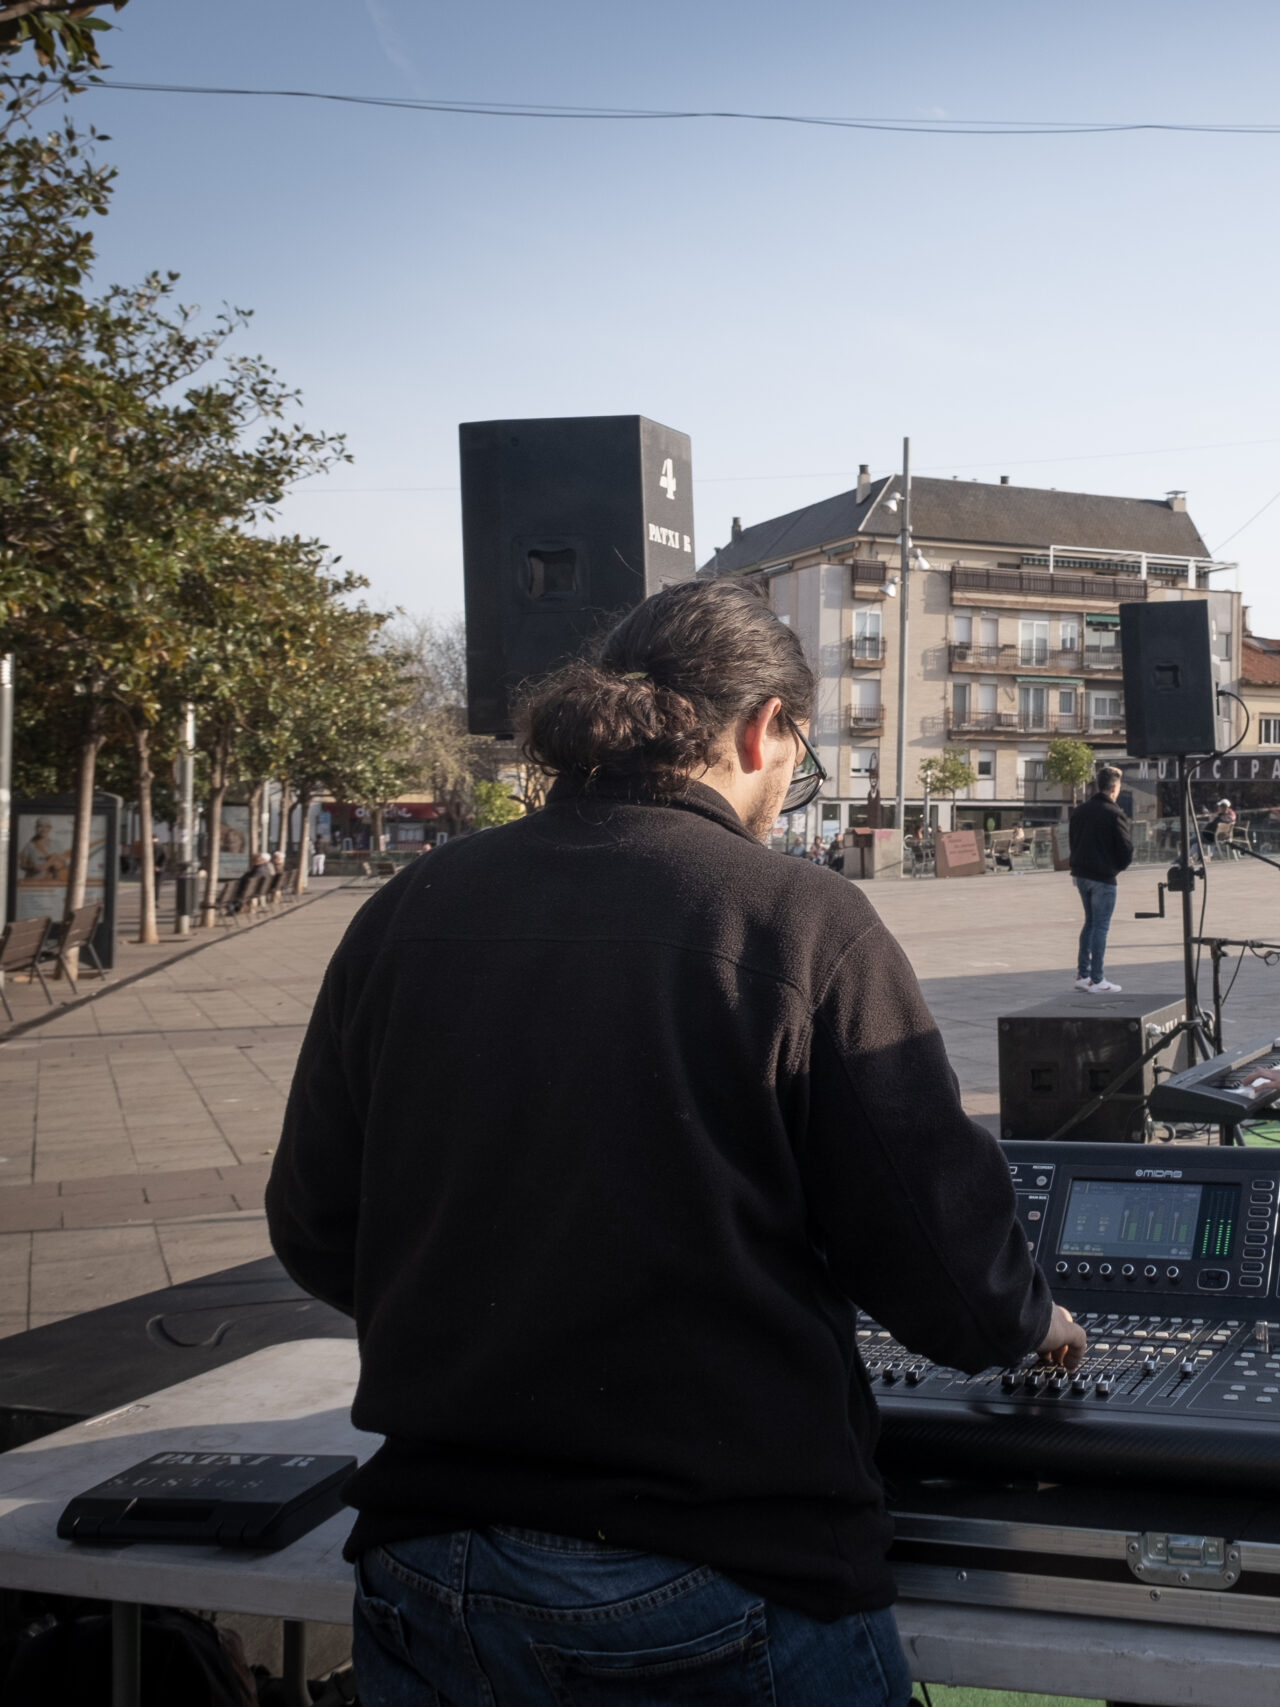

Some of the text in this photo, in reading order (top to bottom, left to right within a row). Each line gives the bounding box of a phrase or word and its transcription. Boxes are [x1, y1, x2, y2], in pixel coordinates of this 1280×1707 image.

[659, 458, 677, 500] 4
[648, 523, 692, 553] PATXI R
[1143, 1169, 1183, 1178] MIDAS
